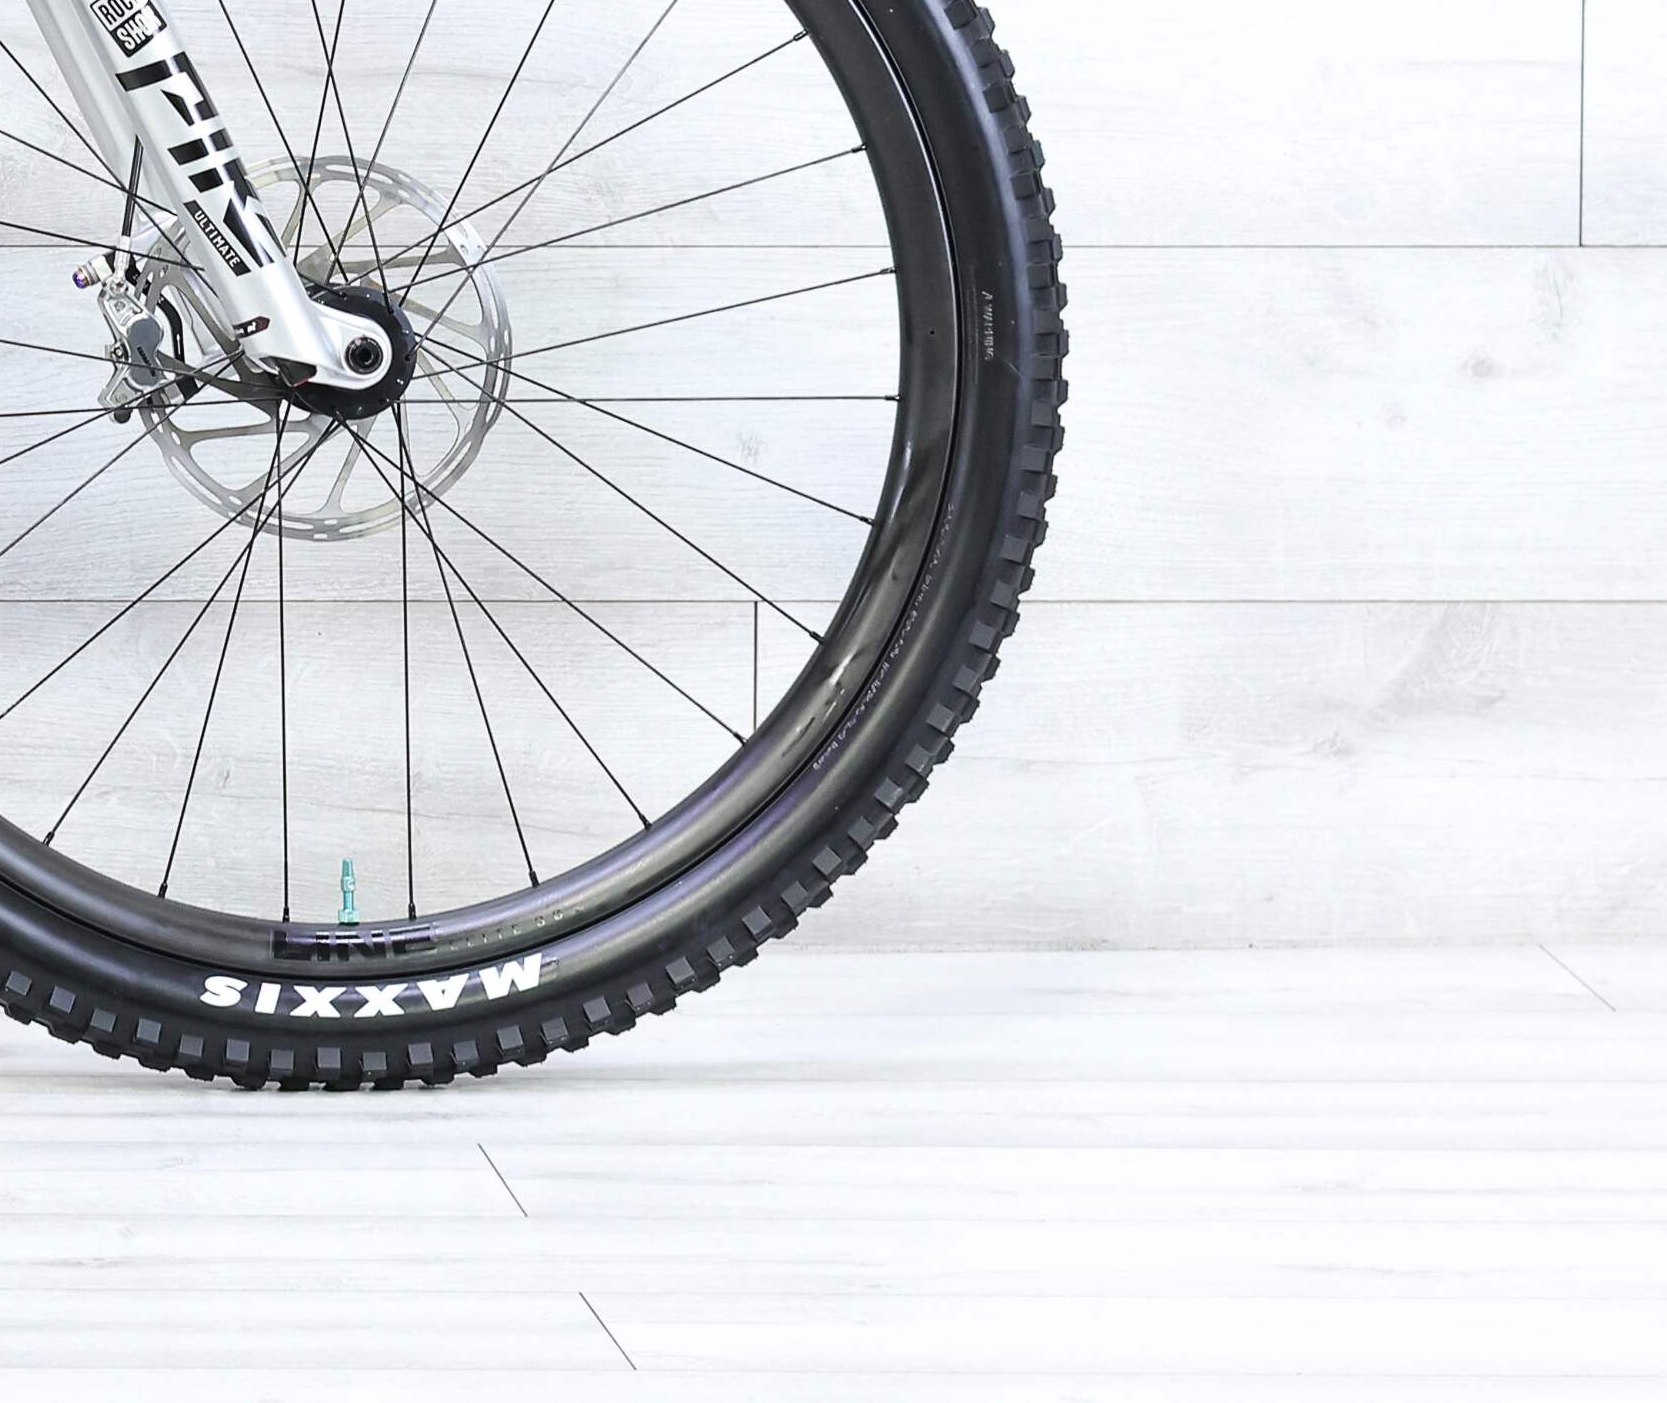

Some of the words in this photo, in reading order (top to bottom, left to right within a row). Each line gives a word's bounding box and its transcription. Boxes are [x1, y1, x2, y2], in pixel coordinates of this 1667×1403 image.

[116, 6, 162, 50] SHO
[194, 210, 240, 268] ULTIMATE
[270, 924, 435, 961] LINE
[200, 952, 543, 1018] MAXXIS
